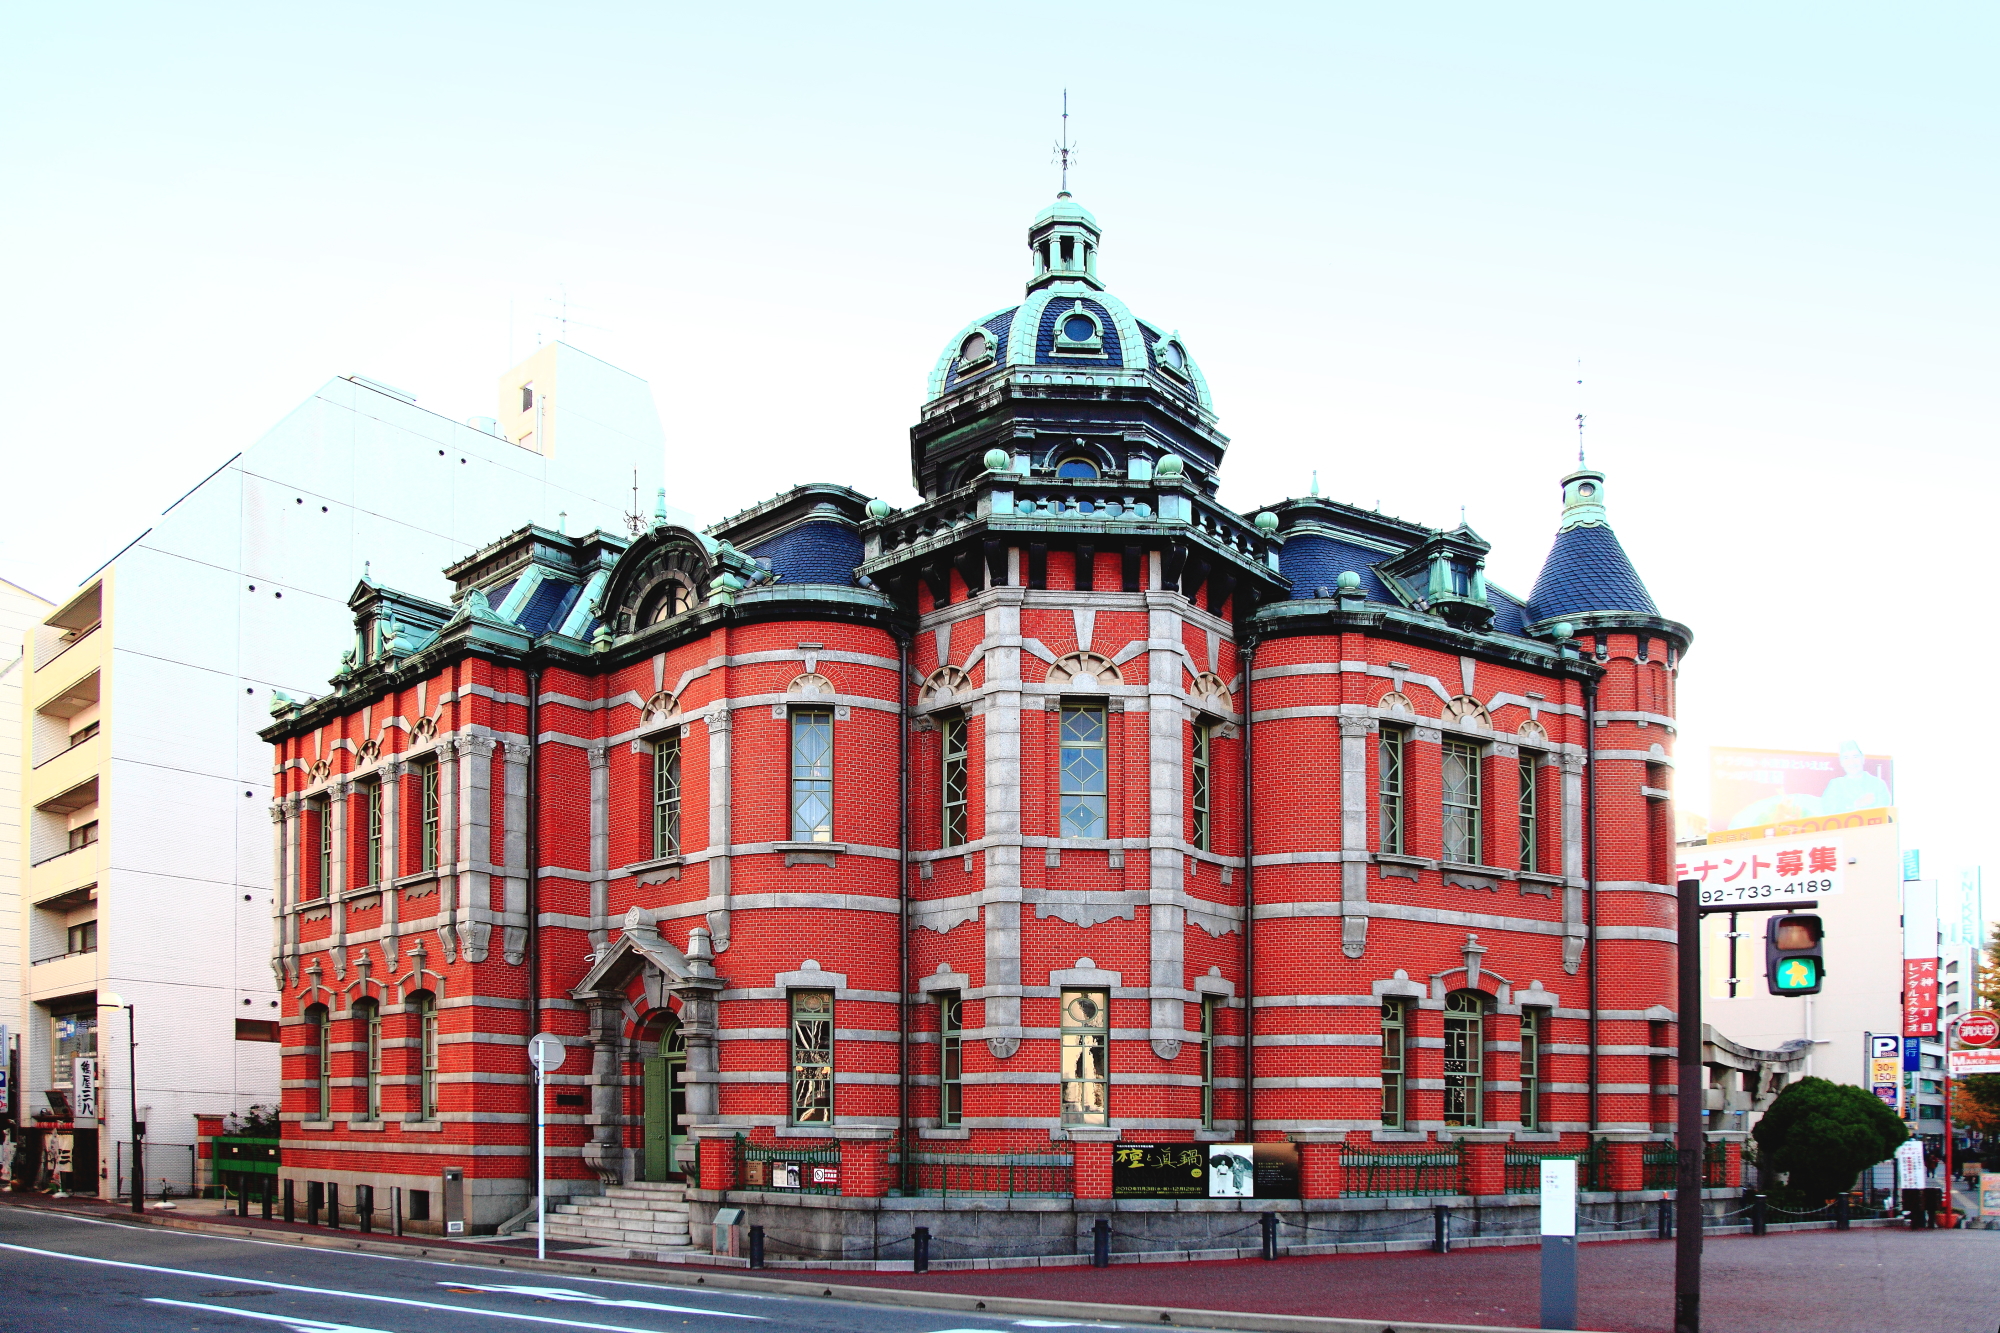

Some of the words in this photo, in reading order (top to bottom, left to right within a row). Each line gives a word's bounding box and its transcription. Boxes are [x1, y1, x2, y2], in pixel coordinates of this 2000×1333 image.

[1907, 962, 1920, 1032] レンタルスタジオ
[1960, 1024, 1995, 1037] 消火栓
